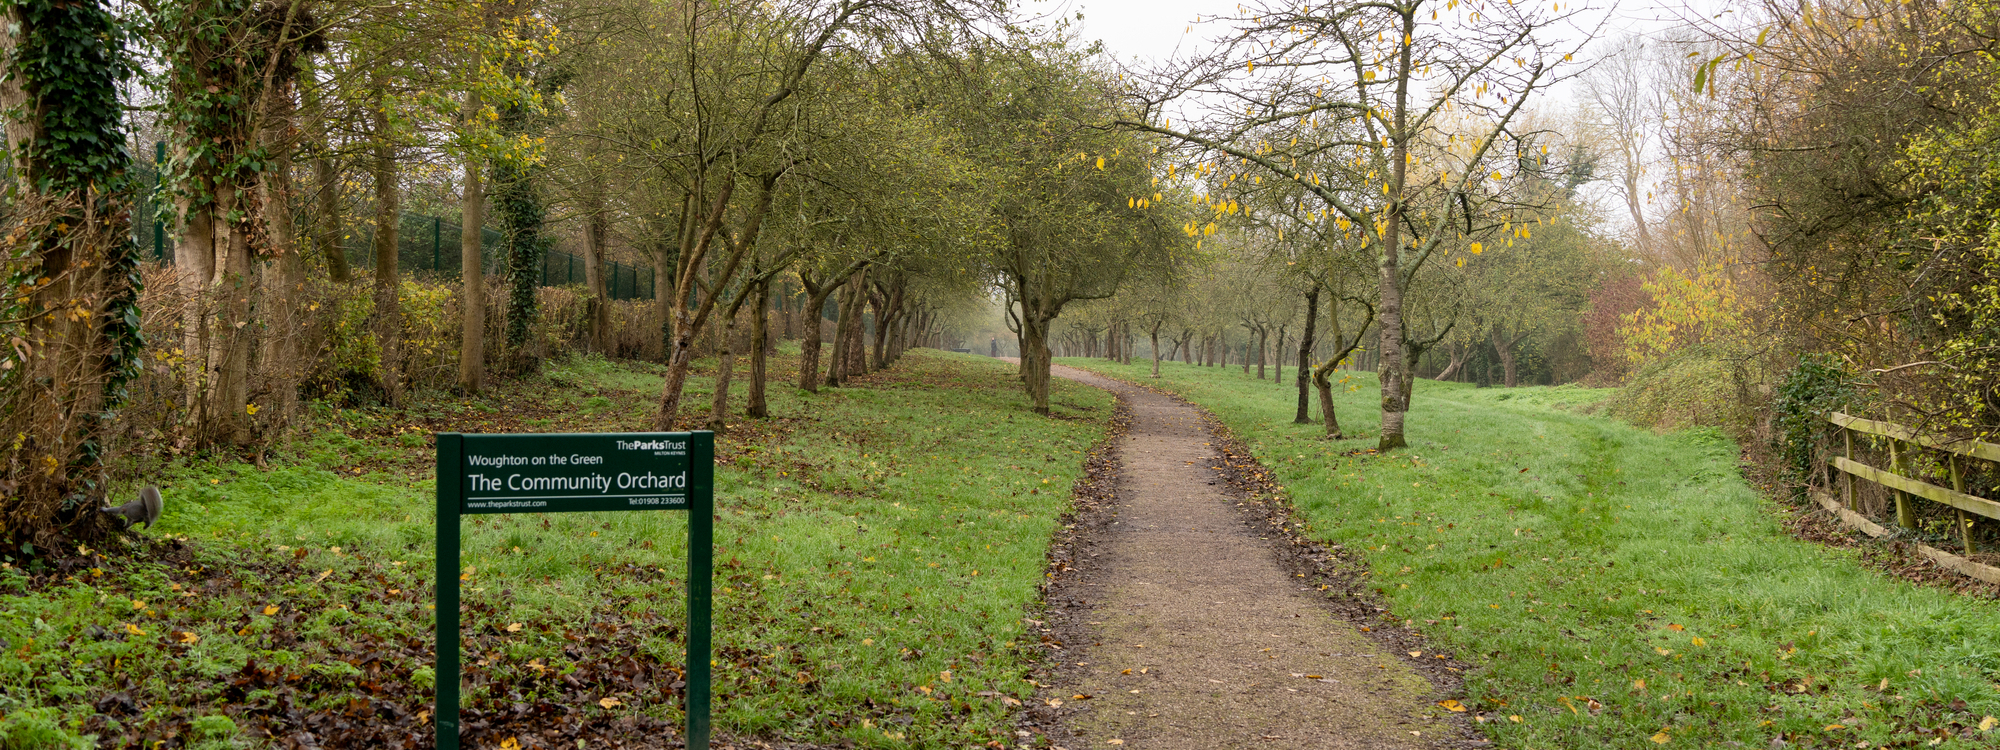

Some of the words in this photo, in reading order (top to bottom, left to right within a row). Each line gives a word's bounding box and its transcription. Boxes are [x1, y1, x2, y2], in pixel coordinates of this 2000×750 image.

[616, 440, 686, 450] TheParksTrust
[468, 454, 529, 469] Woughton
[531, 456, 546, 466] on
[549, 454, 567, 465] the
[570, 453, 603, 465] Green
[468, 473, 502, 491] The
[507, 472, 612, 494] Community
[617, 470, 686, 489] Orchard
[467, 500, 547, 509] www.theparkstrust.com
[660, 497, 685, 505] 233600
